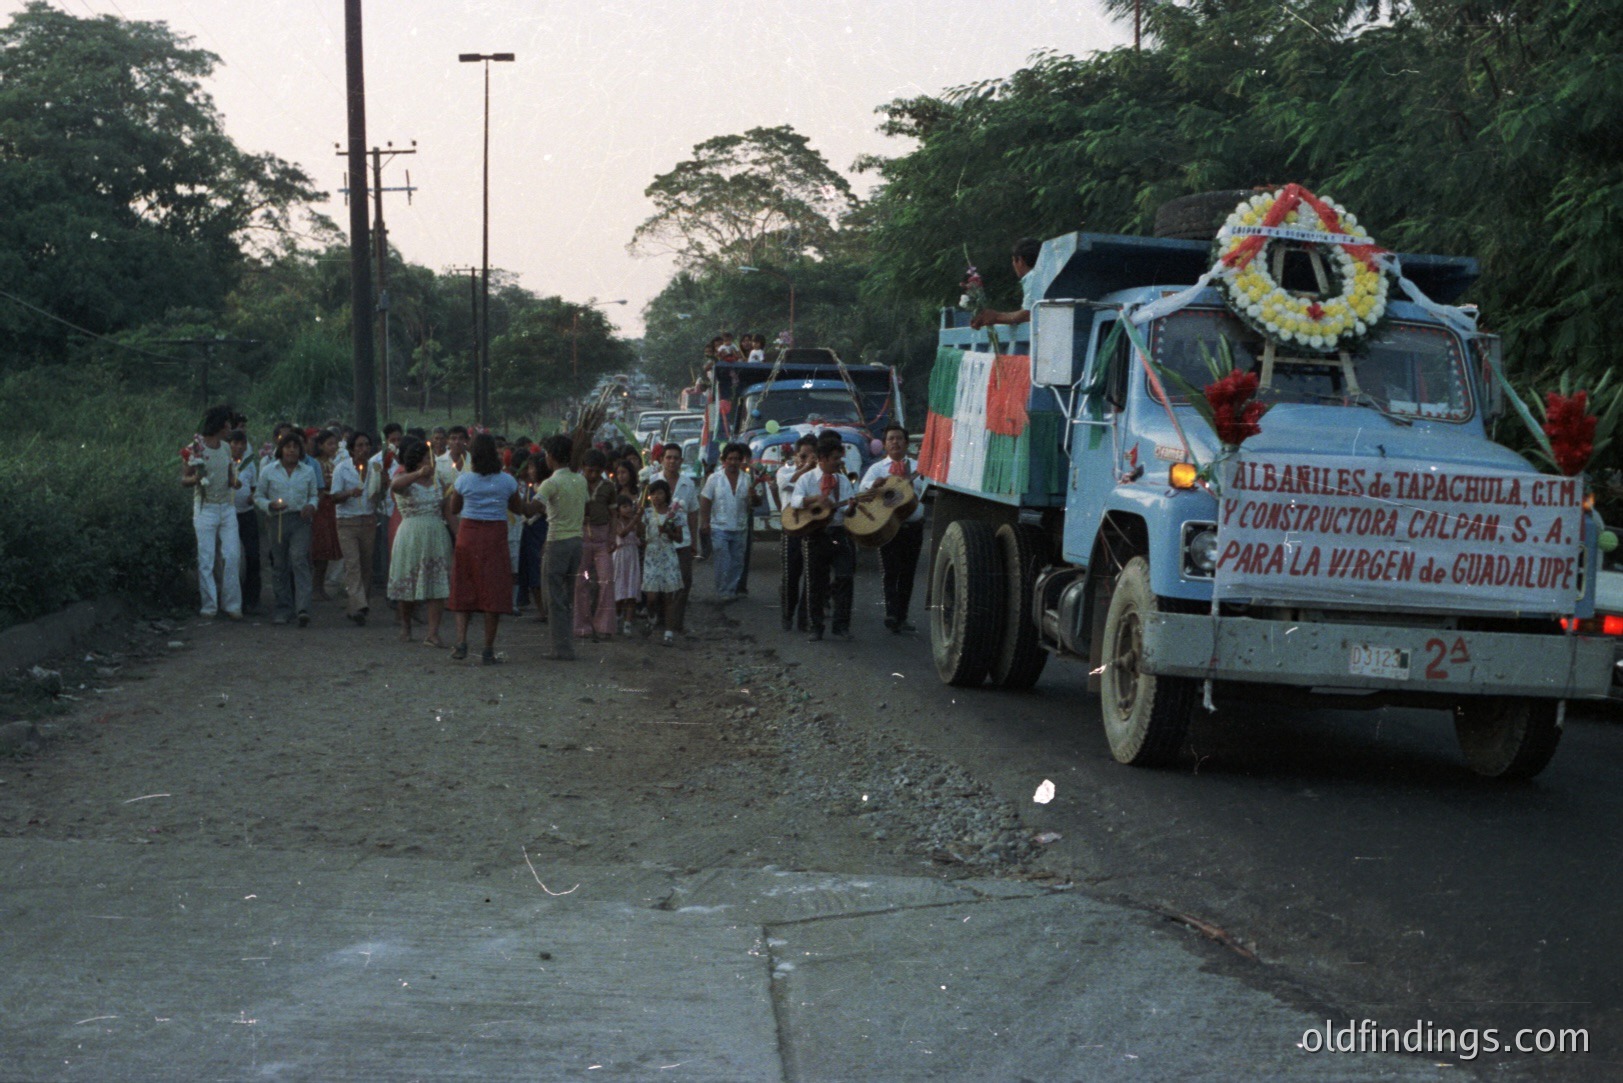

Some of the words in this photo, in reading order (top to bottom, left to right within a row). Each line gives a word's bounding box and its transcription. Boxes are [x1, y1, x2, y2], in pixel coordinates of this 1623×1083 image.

[1232, 461, 1365, 496] ALBAÑILES
[1368, 472, 1391, 499] de
[1394, 471, 1527, 508] TAPACHULA,
[1223, 498, 1238, 525] Y
[1239, 501, 1398, 536] CONSTRUCTORA
[1217, 540, 1284, 574] PARA
[1289, 545, 1321, 577] LA
[1328, 548, 1415, 581] VIRGEN
[1419, 557, 1447, 584] de
[1452, 553, 1575, 590] GUADALUPE
